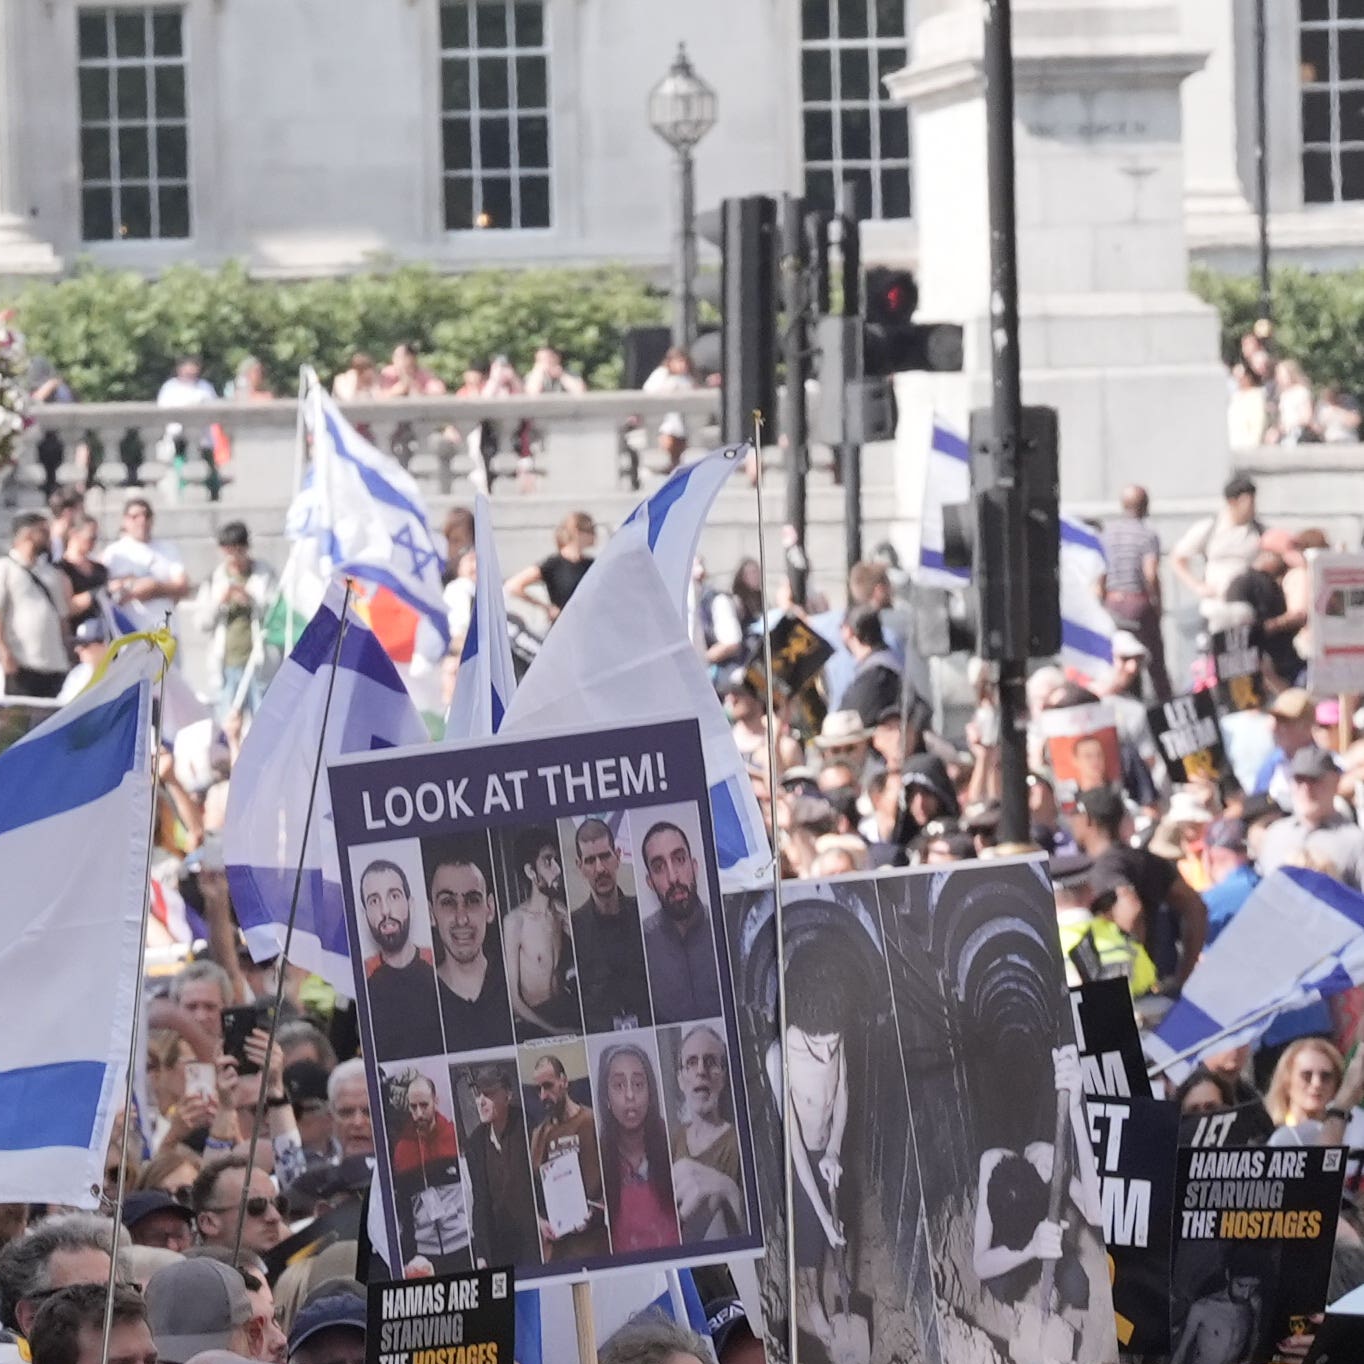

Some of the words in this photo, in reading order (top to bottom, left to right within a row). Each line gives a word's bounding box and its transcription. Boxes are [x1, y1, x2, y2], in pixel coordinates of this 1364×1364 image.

[362, 778, 475, 832] LOOK
[483, 769, 531, 815] AT
[538, 751, 669, 807] THEM!
[1188, 1150, 1265, 1180] HAMAS
[1266, 1150, 1309, 1180] ARE
[1183, 1180, 1285, 1209] STARVING
[1181, 1210, 1216, 1240] THE
[1220, 1210, 1323, 1240] HOSTAGES
[381, 1280, 445, 1321] HAMAS
[447, 1278, 480, 1312] ARE
[380, 1313, 464, 1352] STARVING
